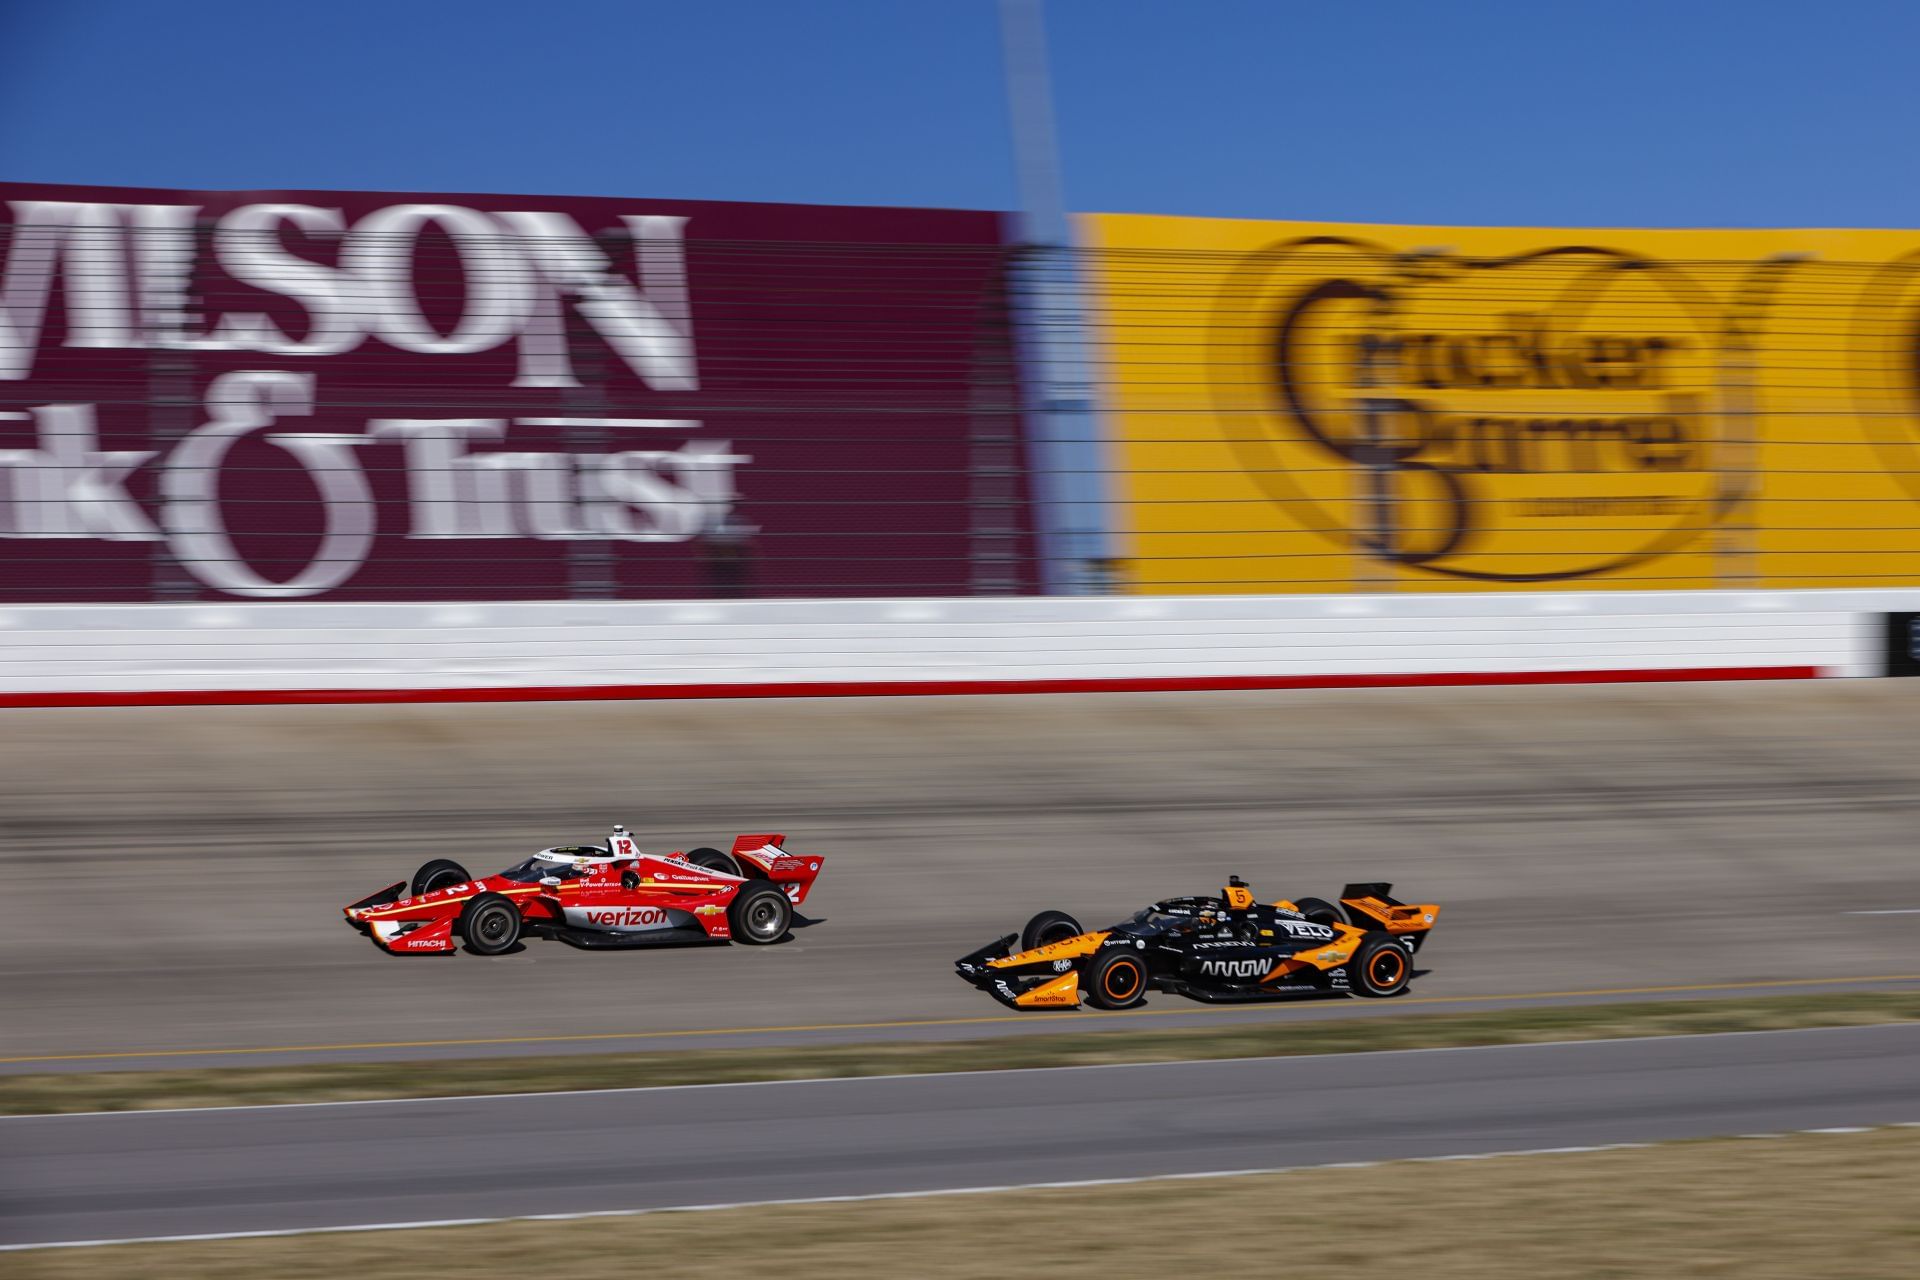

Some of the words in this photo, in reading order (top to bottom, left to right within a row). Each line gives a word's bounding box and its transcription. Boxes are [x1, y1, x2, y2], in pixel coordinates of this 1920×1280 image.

[616, 839, 633, 855] 12
[663, 857, 685, 867] PENSKE
[1235, 890, 1246, 904] 5
[586, 907, 668, 926] verizon
[1274, 919, 1334, 938] VELO
[407, 939, 447, 948] HITACHI
[1200, 958, 1273, 978] ARROW
[1034, 995, 1067, 1003] SmartStop
